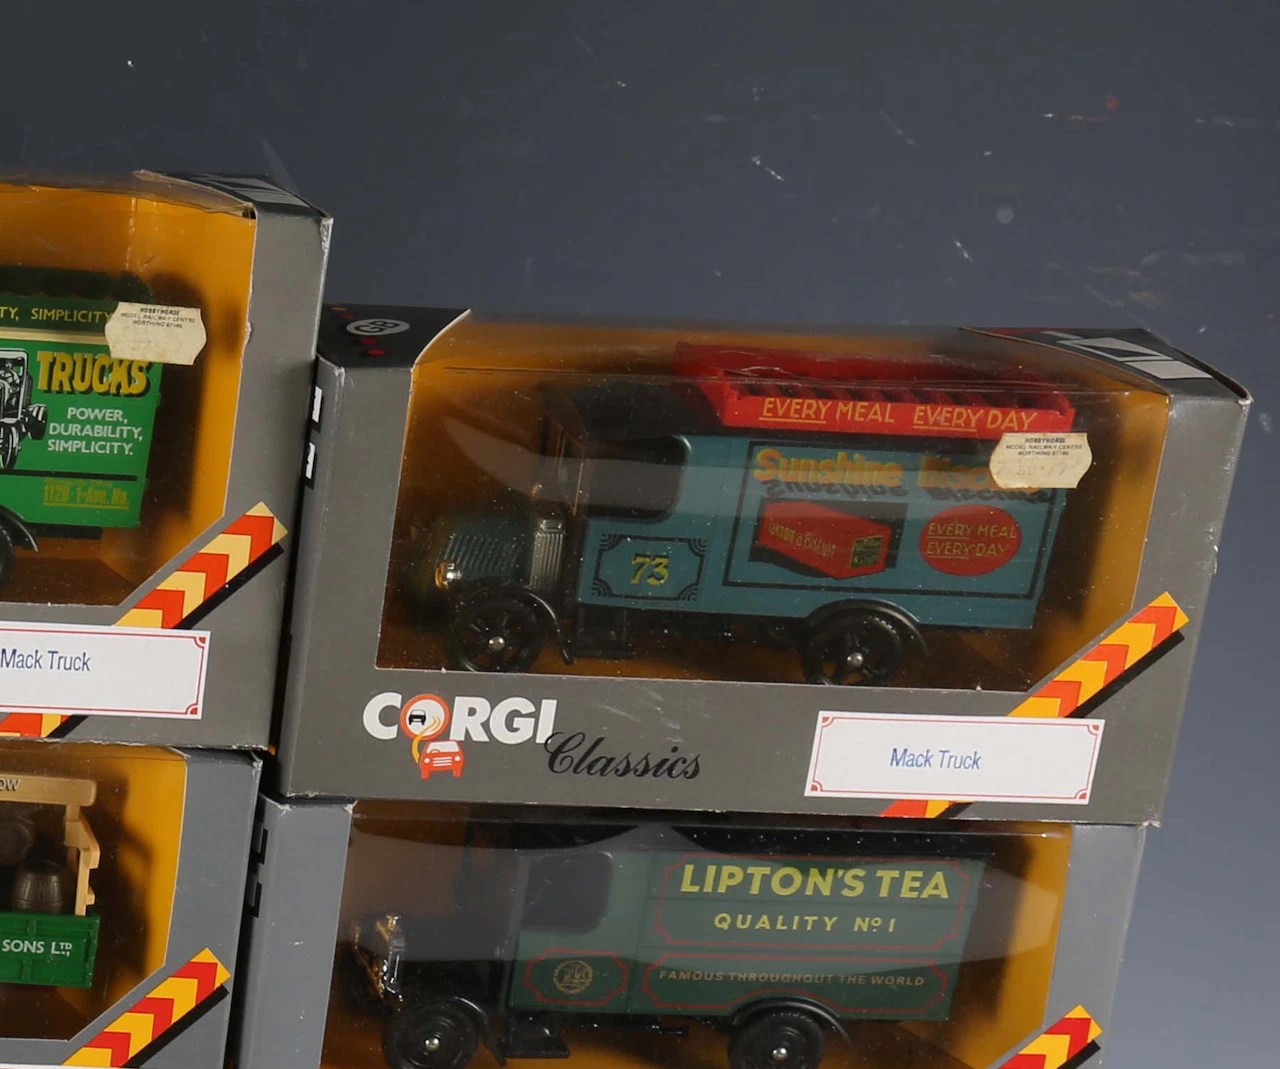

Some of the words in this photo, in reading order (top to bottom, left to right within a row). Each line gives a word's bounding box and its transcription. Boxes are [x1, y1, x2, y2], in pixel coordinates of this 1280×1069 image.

[36, 350, 153, 398] TRUCKS
[67, 407, 128, 424] POWER,
[762, 398, 831, 421] EVERY
[835, 402, 894, 423] MEAL
[913, 405, 981, 428] EVERY
[987, 410, 1038, 431] DAY
[49, 422, 143, 441] DURABILITY,
[928, 522, 972, 538] EVERY
[976, 524, 1017, 538] MEAL
[926, 542, 971, 556] EVERY
[630, 554, 669, 586] 73
[0, 647, 42, 671] Mack
[46, 648, 91, 672] Truck
[362, 692, 558, 745] CORGI
[543, 732, 702, 781] Classics
[889, 747, 933, 769] Mack
[938, 750, 982, 772] Truck
[680, 864, 866, 897] LIPTON'S
[876, 869, 950, 899] TEA
[714, 913, 837, 931] QUALITY
[1, 939, 46, 953] SONS
[659, 970, 724, 981] FAMOUS
[729, 971, 836, 984] THROUGHOUT
[840, 975, 866, 984] THE
[870, 975, 924, 986] WORLD
